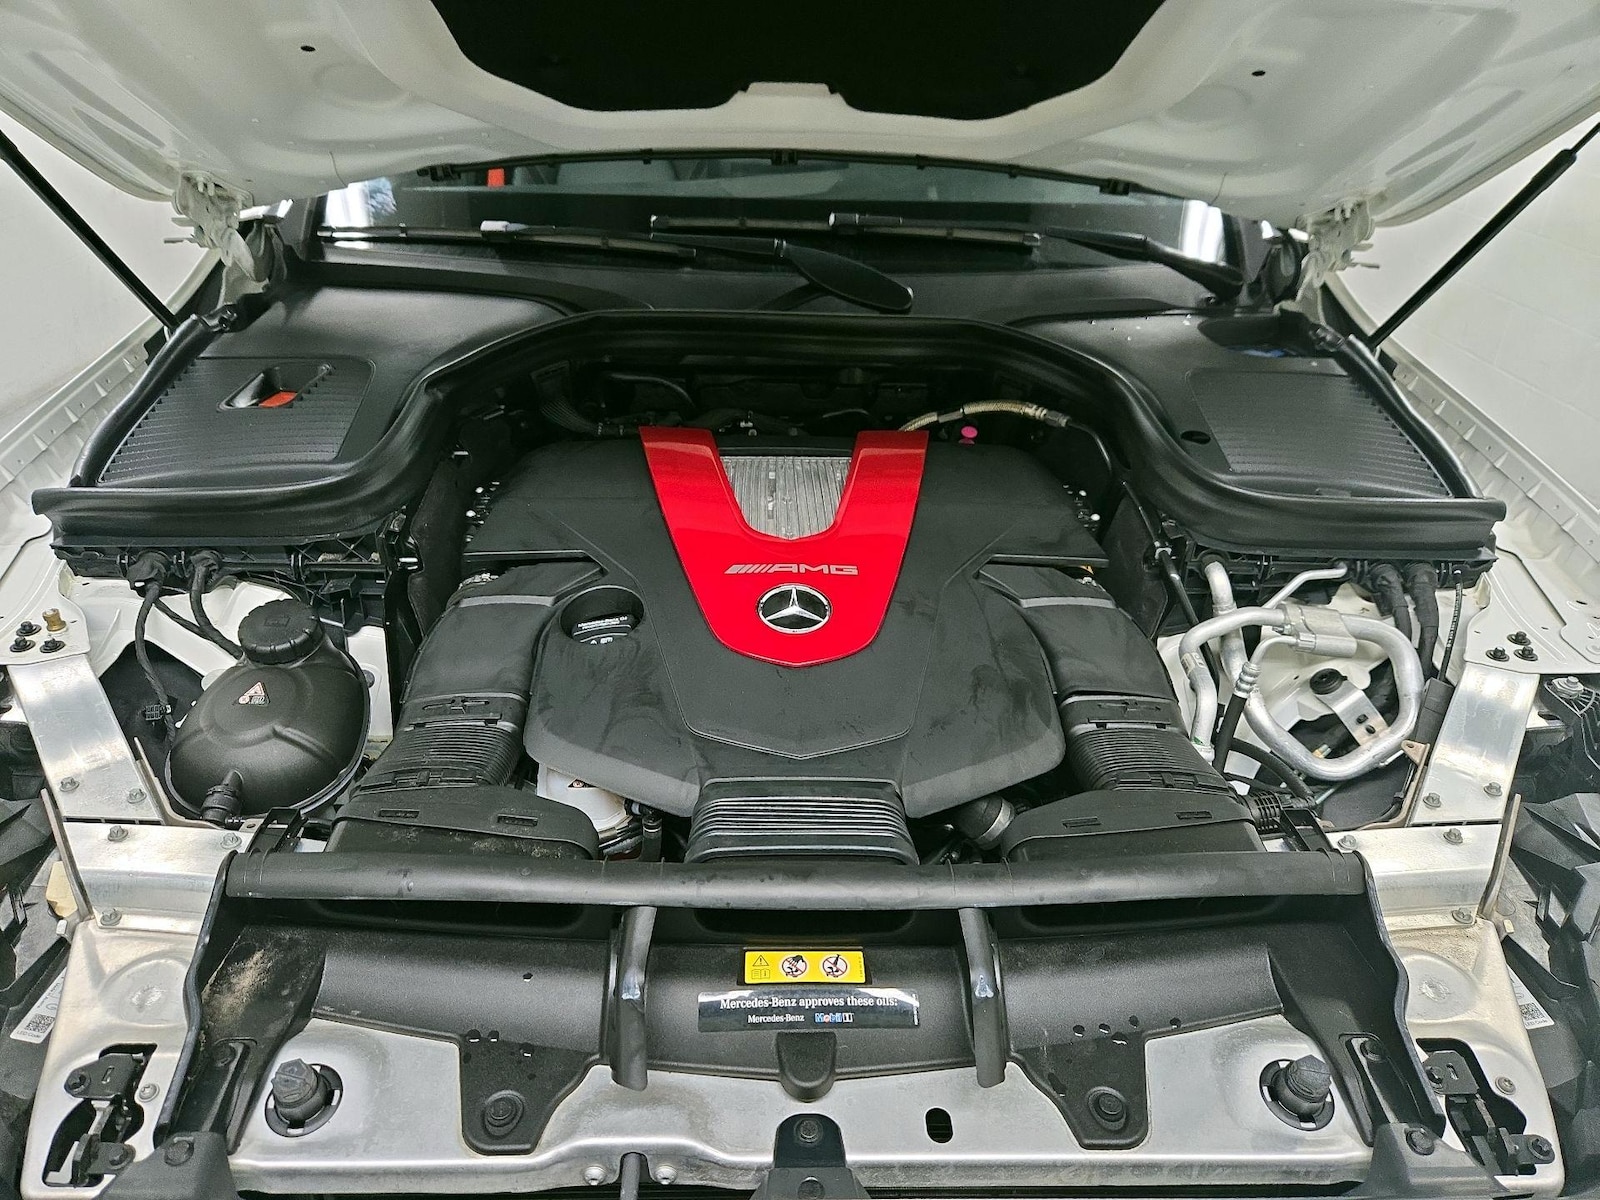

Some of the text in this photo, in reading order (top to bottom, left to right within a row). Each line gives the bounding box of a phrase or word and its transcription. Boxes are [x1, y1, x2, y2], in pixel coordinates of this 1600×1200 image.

[767, 563, 859, 576] AMG
[720, 996, 898, 1009] Mercedes-Benz approves these oils:
[748, 1013, 805, 1023] Mercedes-Benz
[815, 1012, 842, 1023] Mobil
